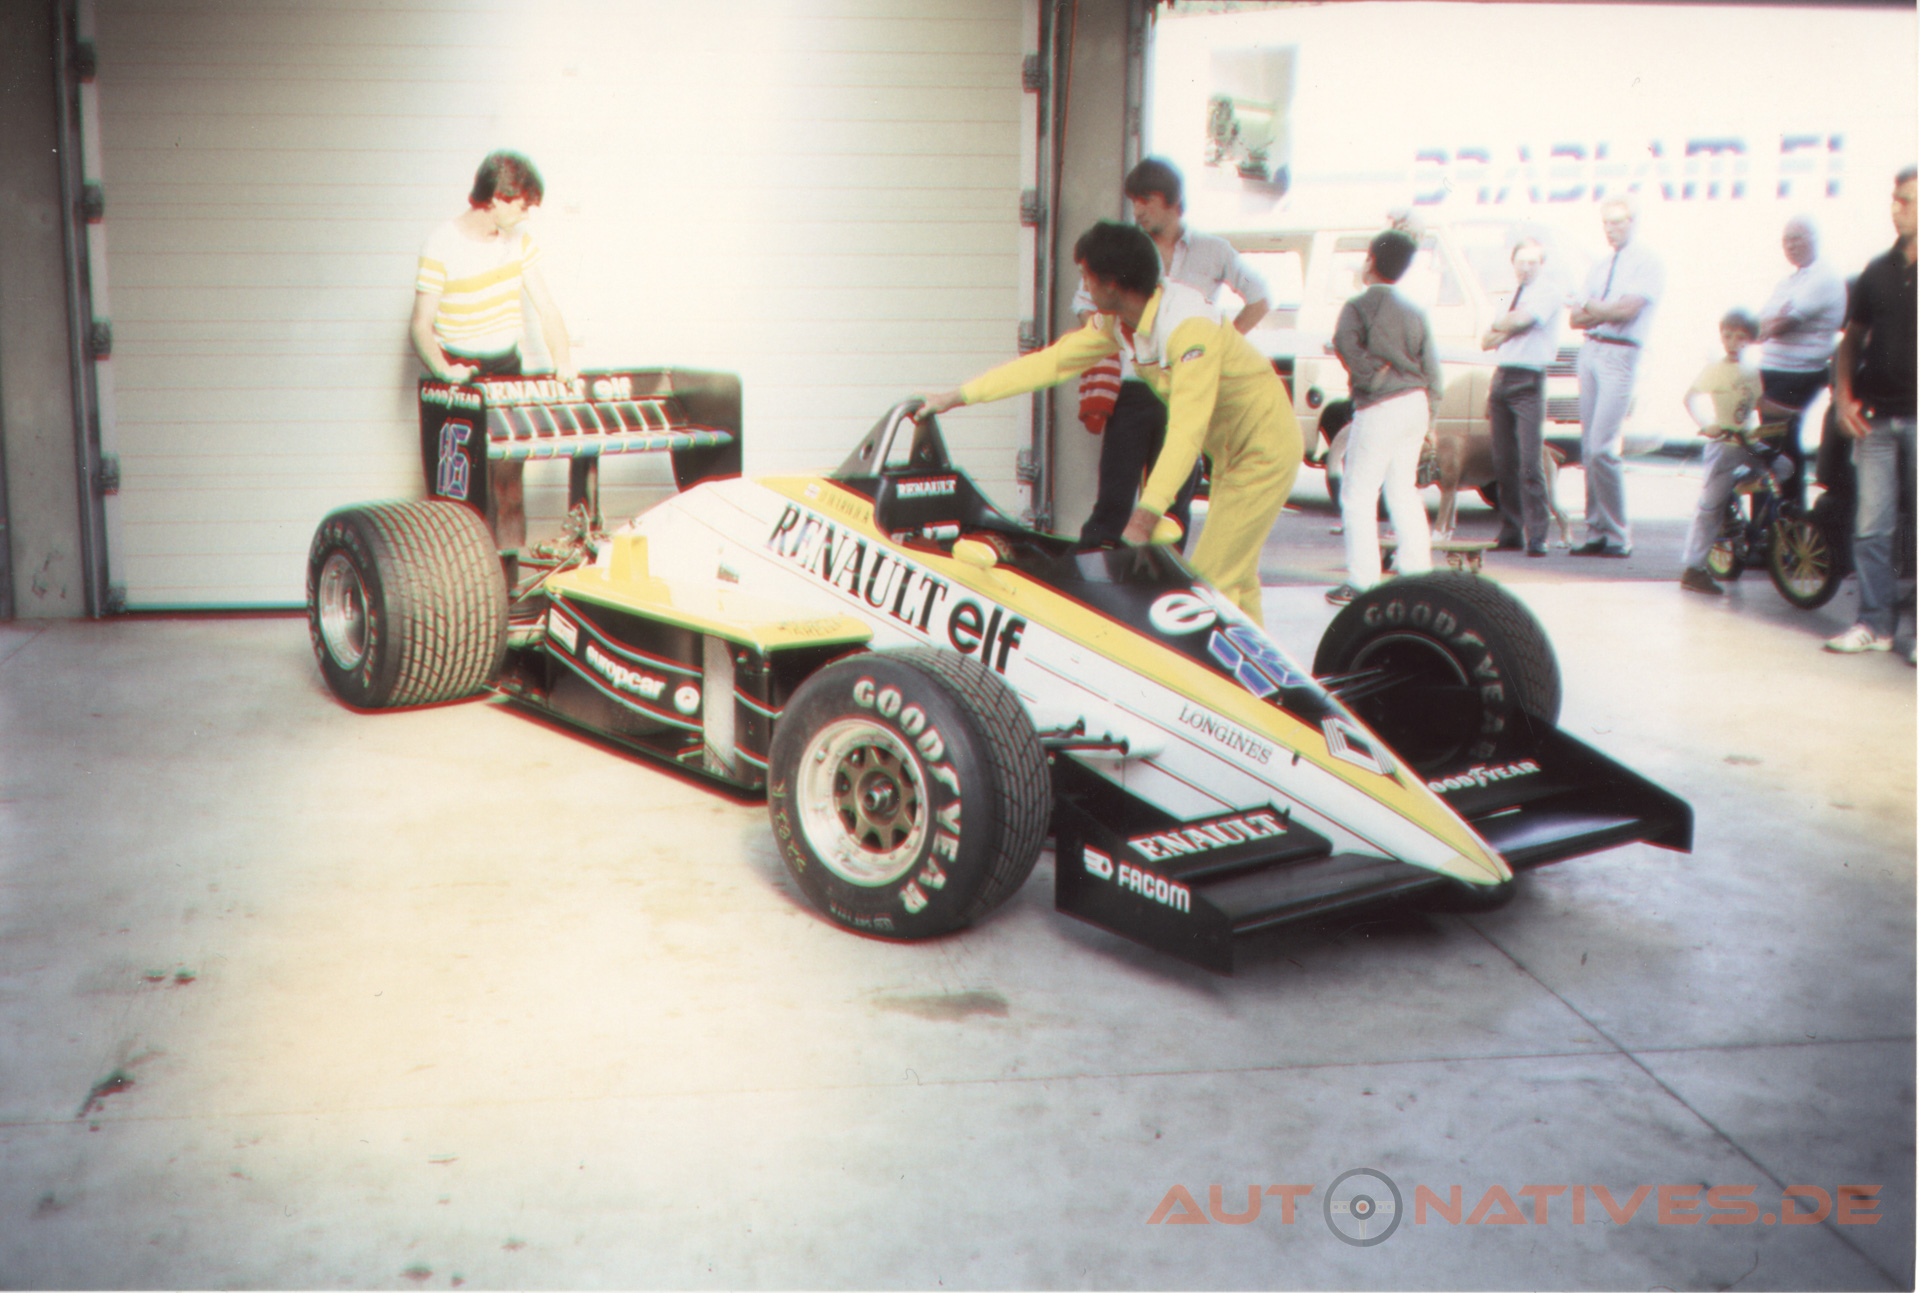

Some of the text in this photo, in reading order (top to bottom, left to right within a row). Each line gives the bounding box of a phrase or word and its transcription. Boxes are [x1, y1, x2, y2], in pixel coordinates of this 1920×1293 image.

[593, 375, 633, 402] elf
[435, 420, 472, 500] 16
[896, 476, 958, 498] RENAULT
[764, 501, 949, 634] RENAULT
[948, 597, 1028, 675] elf
[585, 641, 668, 700] europcar
[1178, 702, 1275, 766] LONGINES
[1427, 758, 1541, 794] OODYEAR
[1126, 809, 1288, 862] ENAULT
[1117, 863, 1191, 913] FACOM
